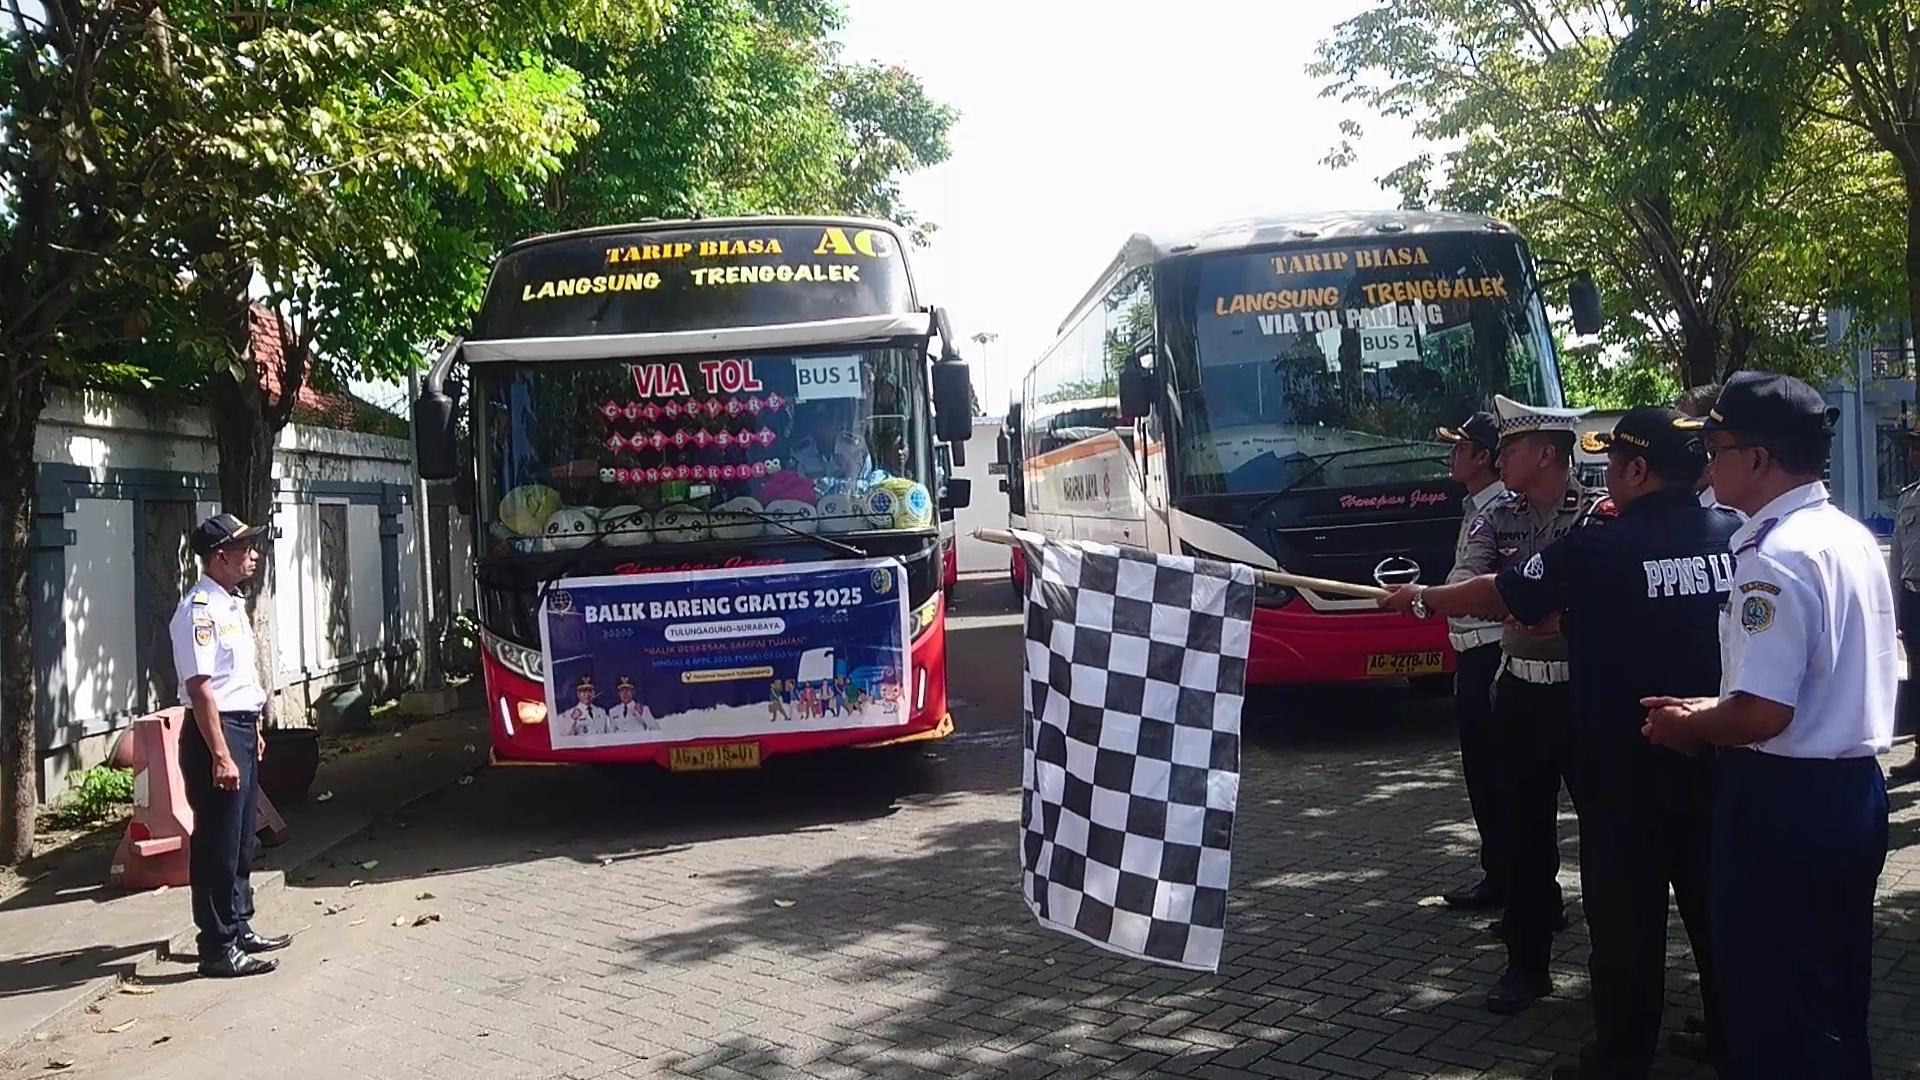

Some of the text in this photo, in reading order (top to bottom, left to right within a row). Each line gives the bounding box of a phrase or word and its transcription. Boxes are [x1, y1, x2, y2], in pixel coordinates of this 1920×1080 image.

[606, 239, 783, 264] TARIP BIASA
[813, 228, 895, 258] AC
[1271, 247, 1430, 275] TARIP BIASA
[522, 264, 861, 302] LANGSUNG TRENGGALEK
[1215, 276, 1508, 316] LANGSUNG TRENGGALEK
[1258, 303, 1444, 336] VIA TOL PANJANG
[1363, 334, 1415, 351] BUS 2
[632, 358, 763, 398] VIA TOL
[798, 367, 858, 387] BUS 1
[603, 395, 781, 420] GUINEVERE
[1643, 553, 1734, 598] PPNS LL
[585, 586, 863, 623] BALIK BARENG GRATIS 2025
[1370, 655, 1385, 669] AG
[1426, 652, 1441, 666] US
